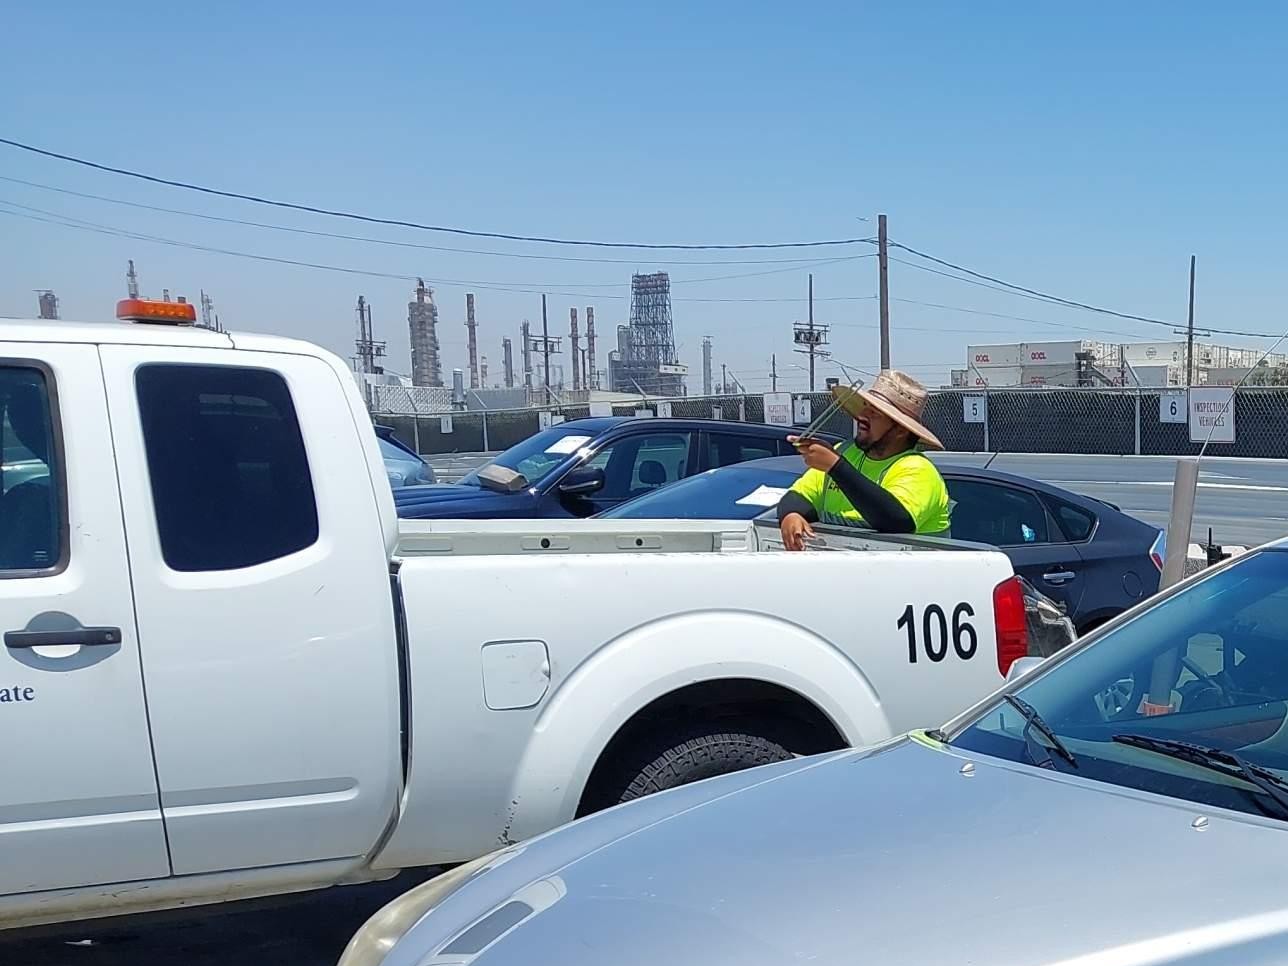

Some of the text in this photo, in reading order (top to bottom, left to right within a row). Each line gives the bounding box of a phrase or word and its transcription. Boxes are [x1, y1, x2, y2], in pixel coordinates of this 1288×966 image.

[972, 403, 978, 417] 5
[1170, 401, 1177, 416] 6
[897, 601, 977, 664] 106
